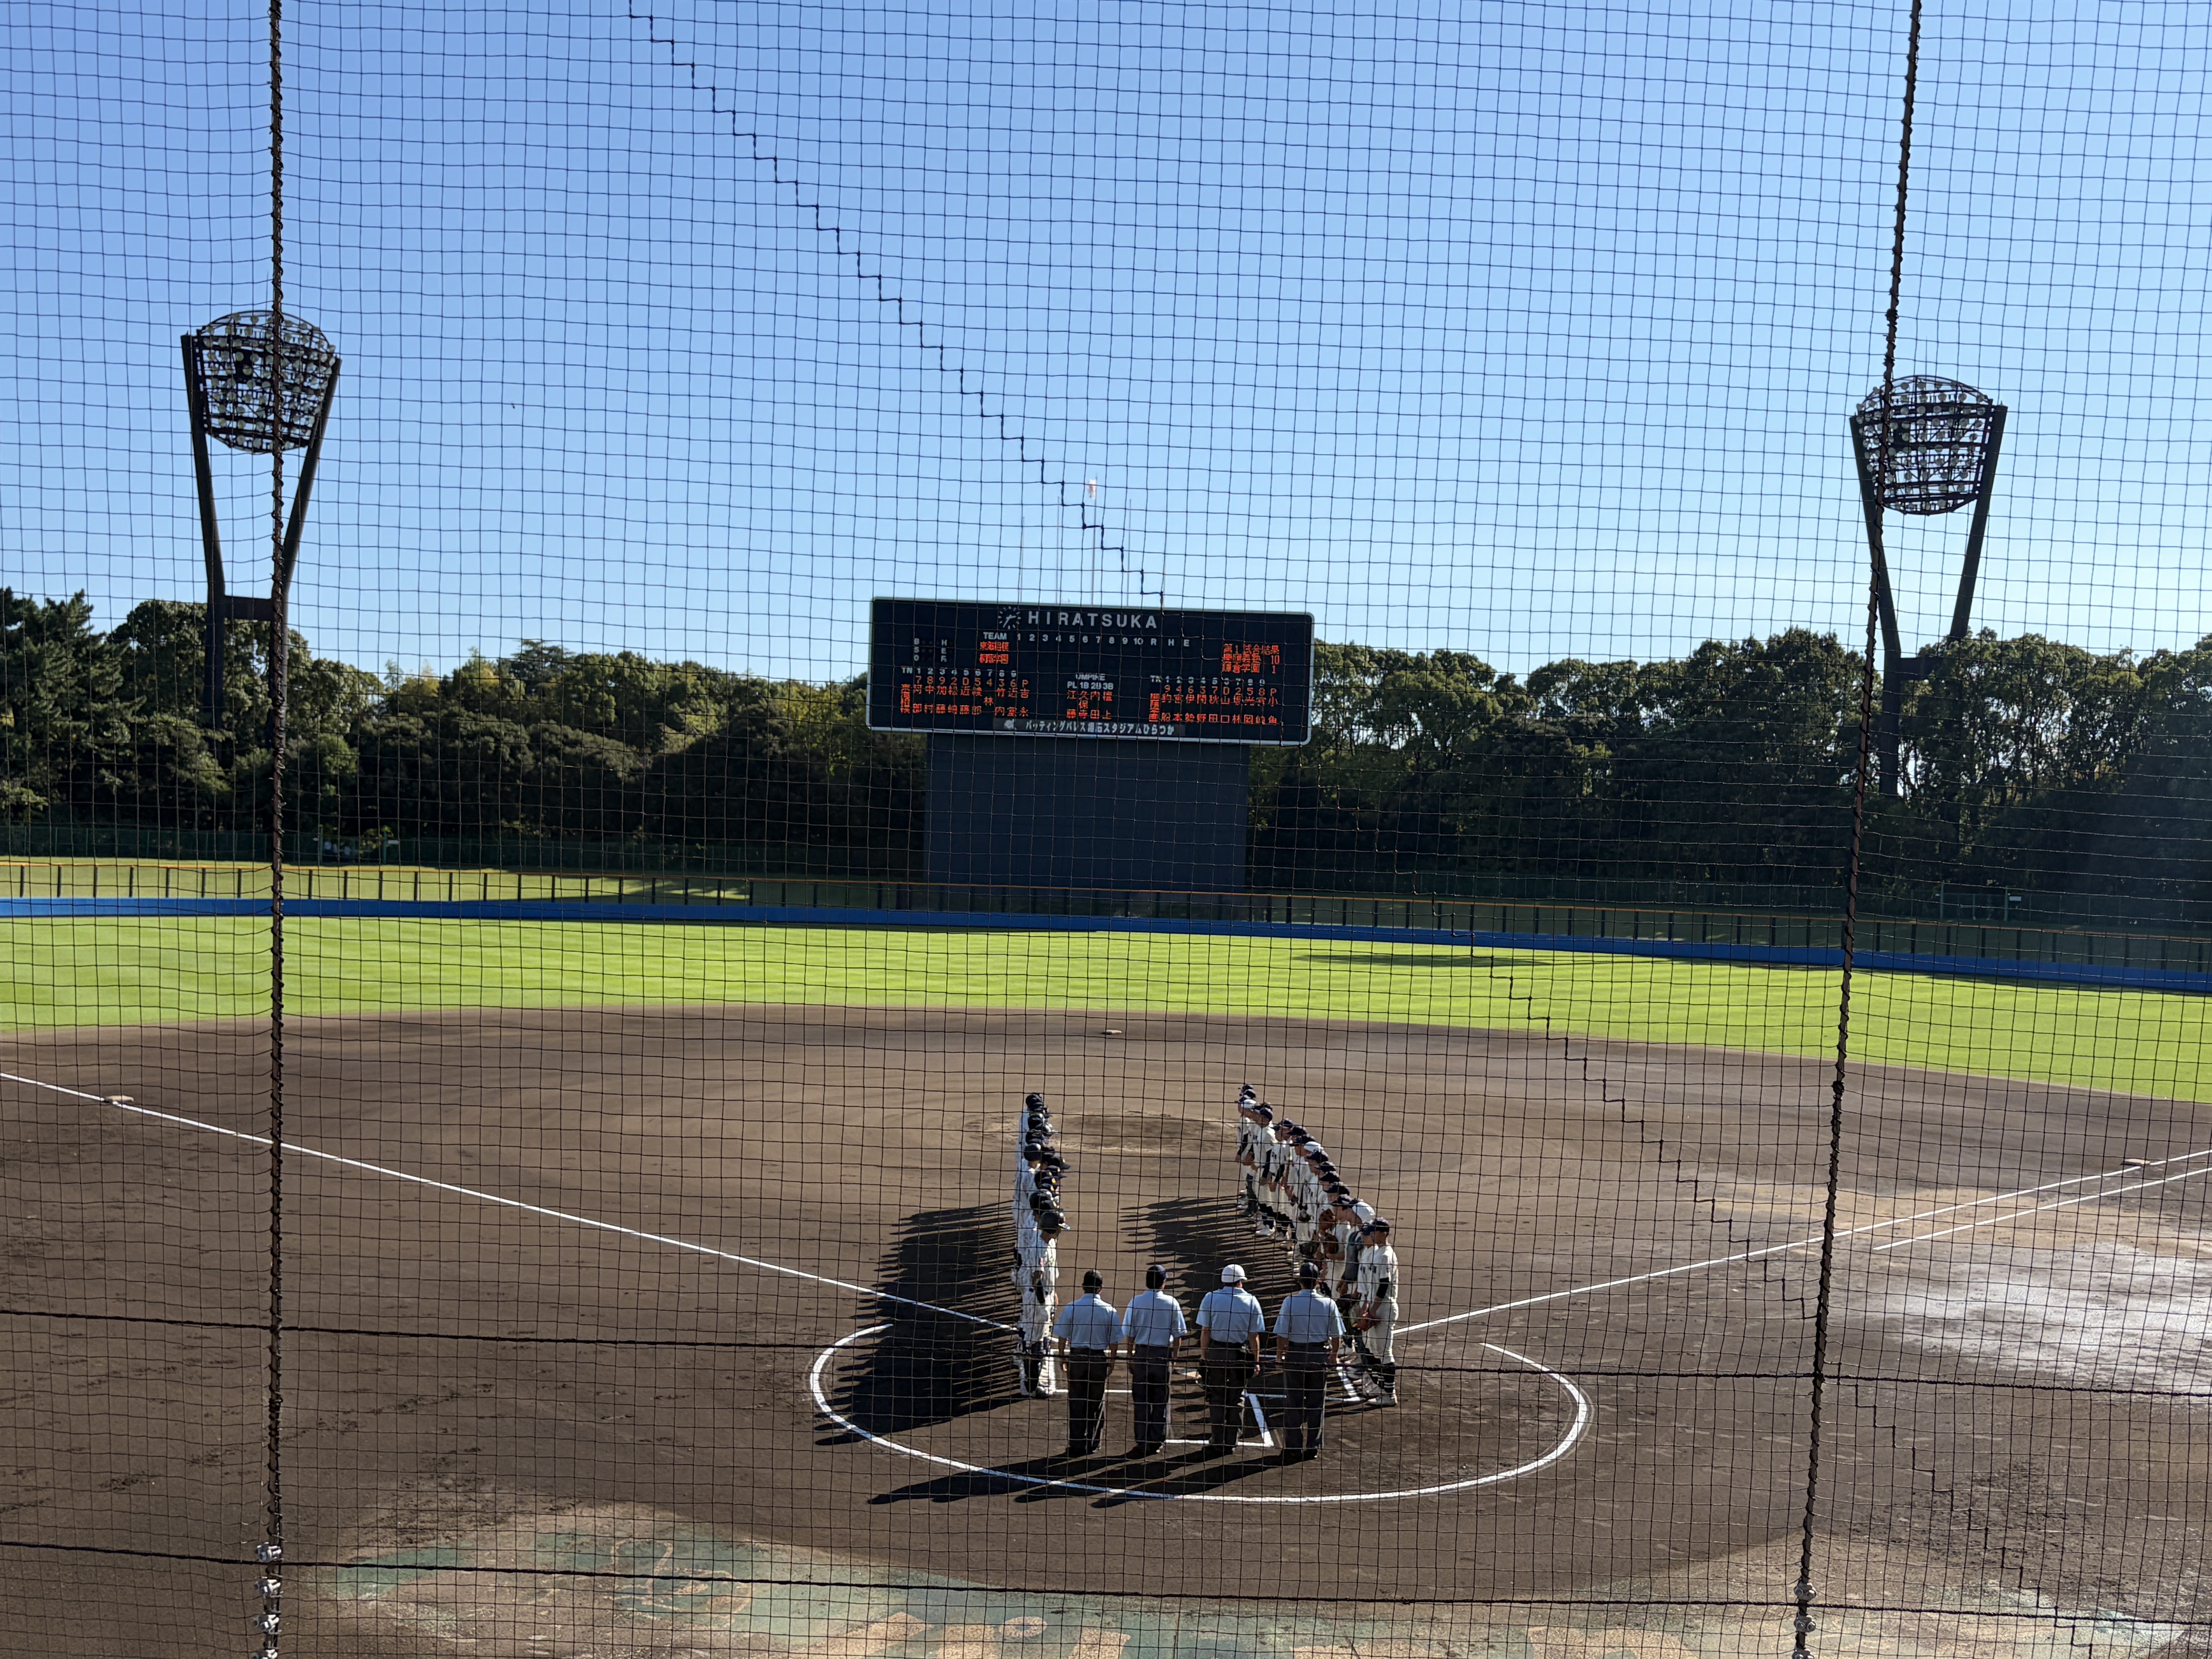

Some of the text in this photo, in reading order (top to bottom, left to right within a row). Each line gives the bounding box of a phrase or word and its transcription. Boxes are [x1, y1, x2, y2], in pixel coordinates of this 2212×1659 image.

[1028, 611, 1157, 629] HIRATSUKA
[1271, 655, 1279, 665] 10
[1272, 665, 1276, 674] 1
[915, 675, 921, 684] 7
[927, 676, 933, 684] 8
[939, 677, 945, 685] 9
[974, 678, 981, 686] 5
[999, 678, 1005, 687] 3
[1010, 679, 1016, 687] 6
[1022, 679, 1028, 687] P
[1164, 684, 1170, 693] 9
[1188, 685, 1194, 694] 6
[1200, 686, 1206, 694] 3
[1212, 686, 1218, 694] 7
[1235, 687, 1242, 696] 2
[1247, 687, 1254, 696] 5
[1259, 688, 1265, 696] 8
[983, 696, 993, 706] 林
[1220, 696, 1230, 723] 山口
